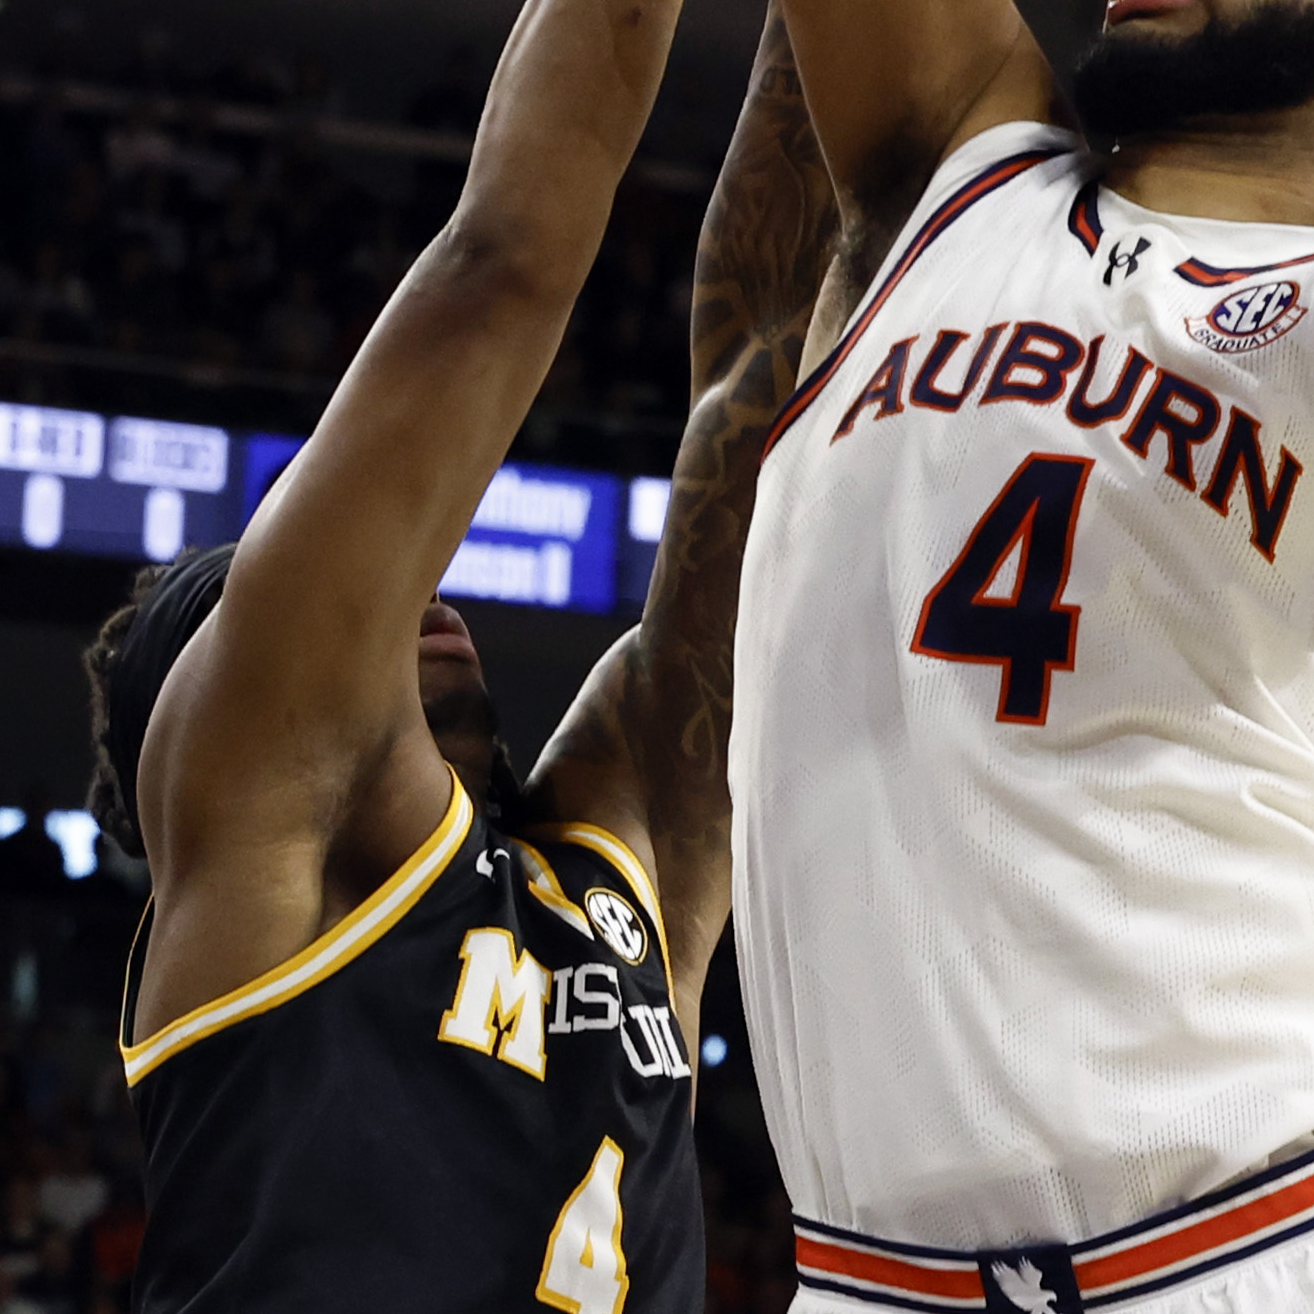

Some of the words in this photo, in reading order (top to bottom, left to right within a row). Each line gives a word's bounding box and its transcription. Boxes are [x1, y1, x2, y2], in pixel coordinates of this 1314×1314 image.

[1194, 322, 1286, 351] GRADUATE
[1215, 282, 1293, 334] SEC
[829, 320, 1304, 564] AUBURN
[909, 452, 1096, 726] 4
[588, 892, 643, 960] SEC
[534, 1134, 630, 1314] 4
